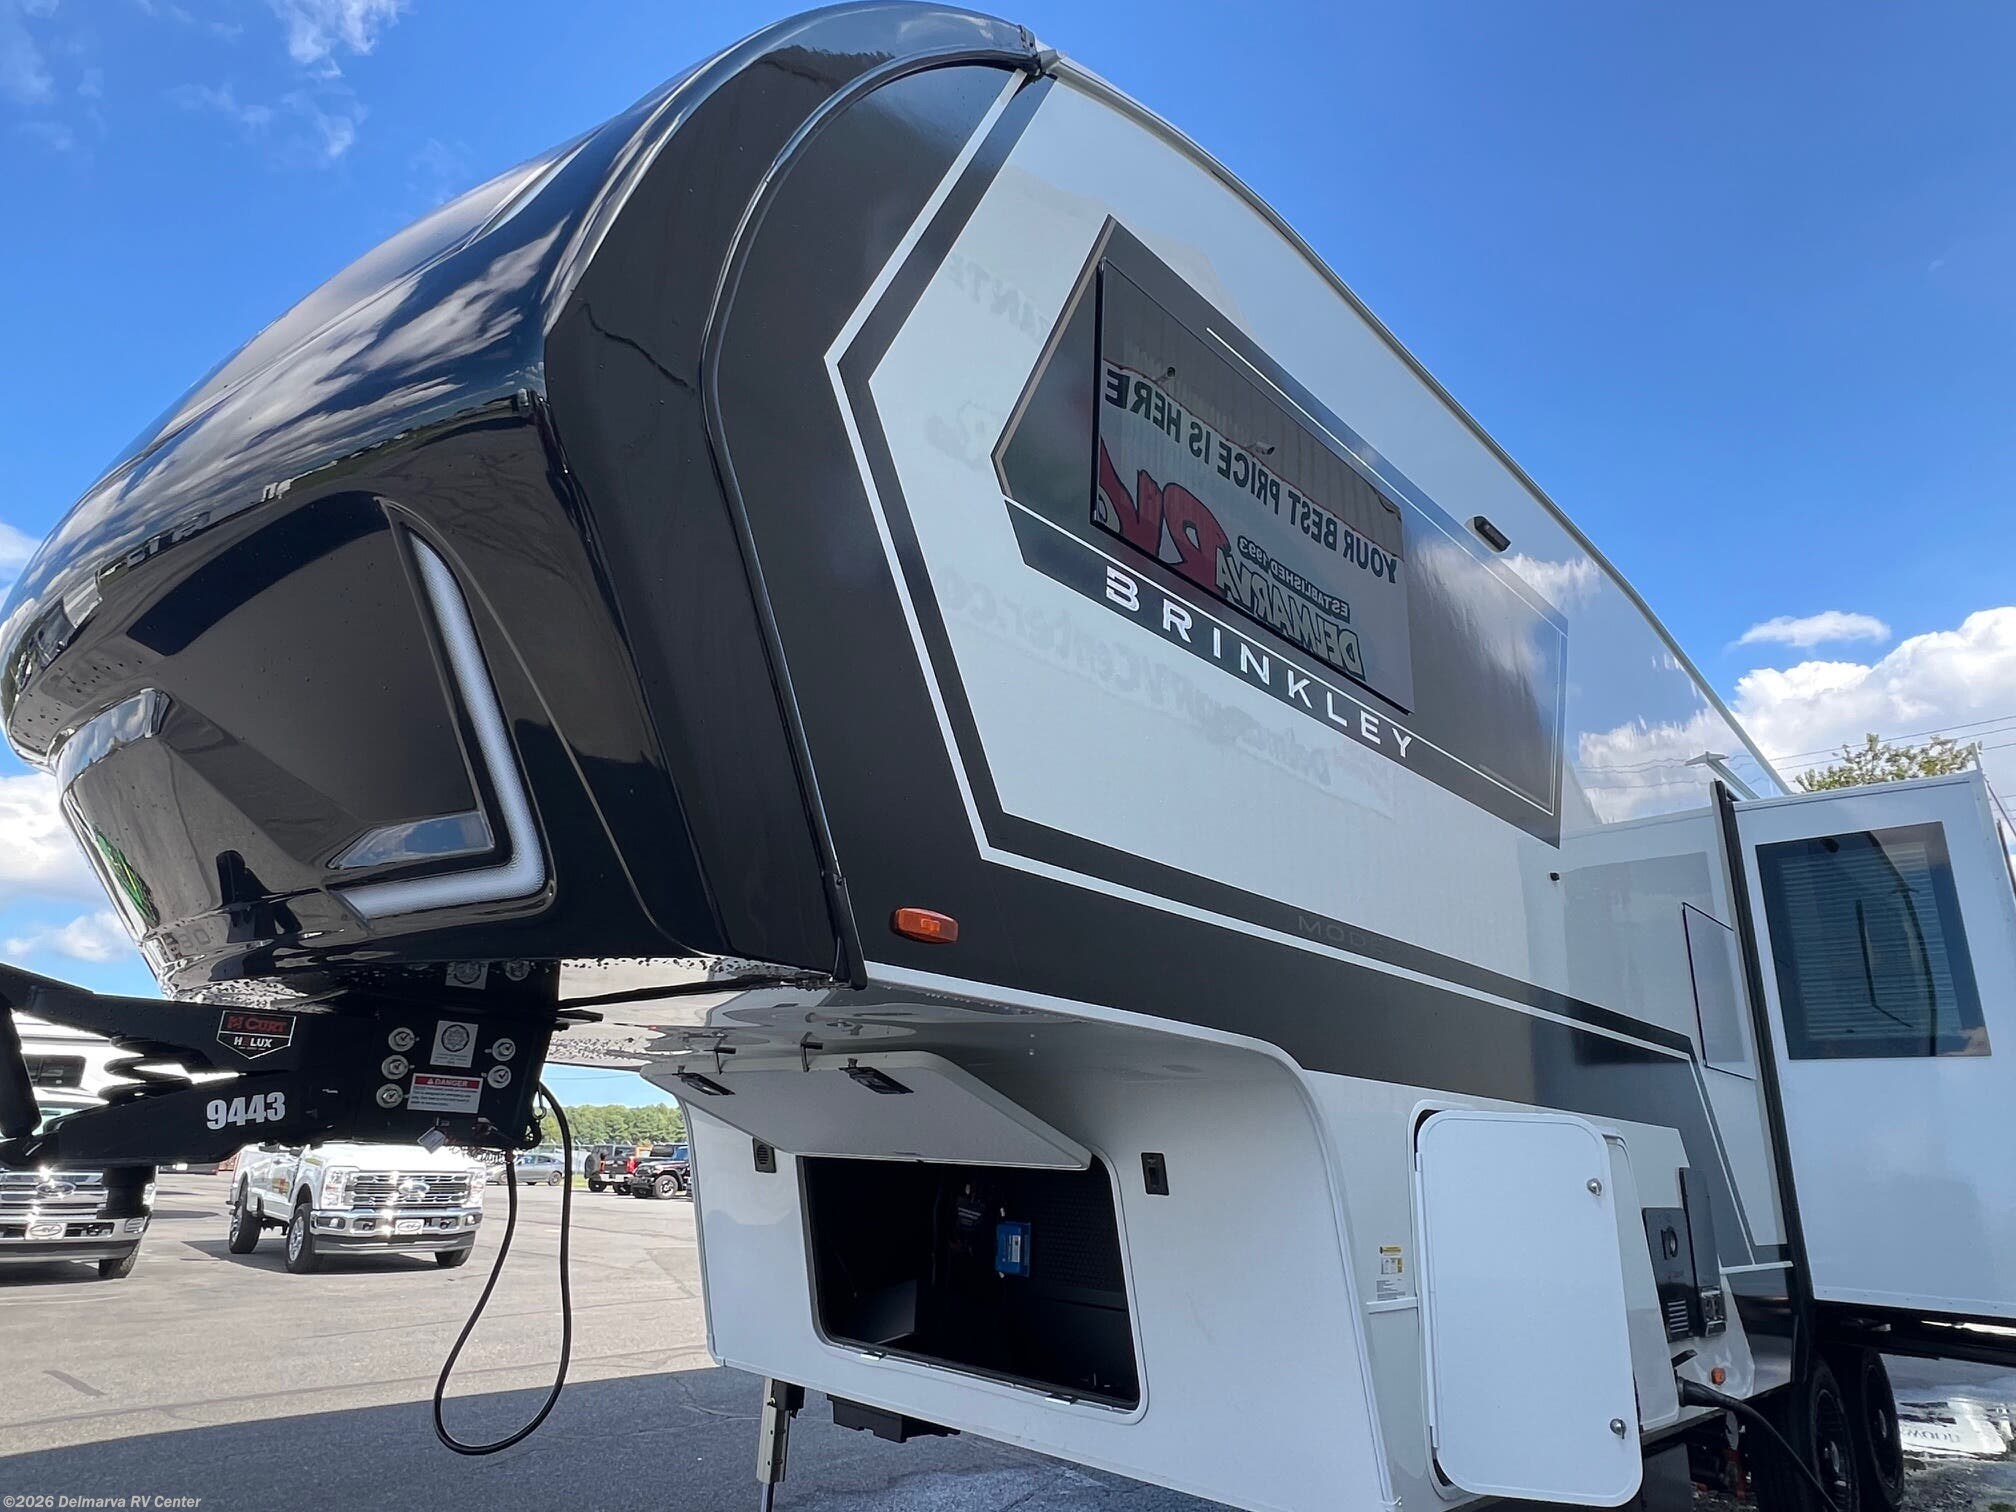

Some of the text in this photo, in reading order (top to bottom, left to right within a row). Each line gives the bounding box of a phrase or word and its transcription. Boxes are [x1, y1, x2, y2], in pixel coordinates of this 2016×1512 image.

[1105, 565, 1413, 758] BRINKLEY
[434, 1078, 469, 1088] DANGER
[206, 1091, 286, 1130] 9443
